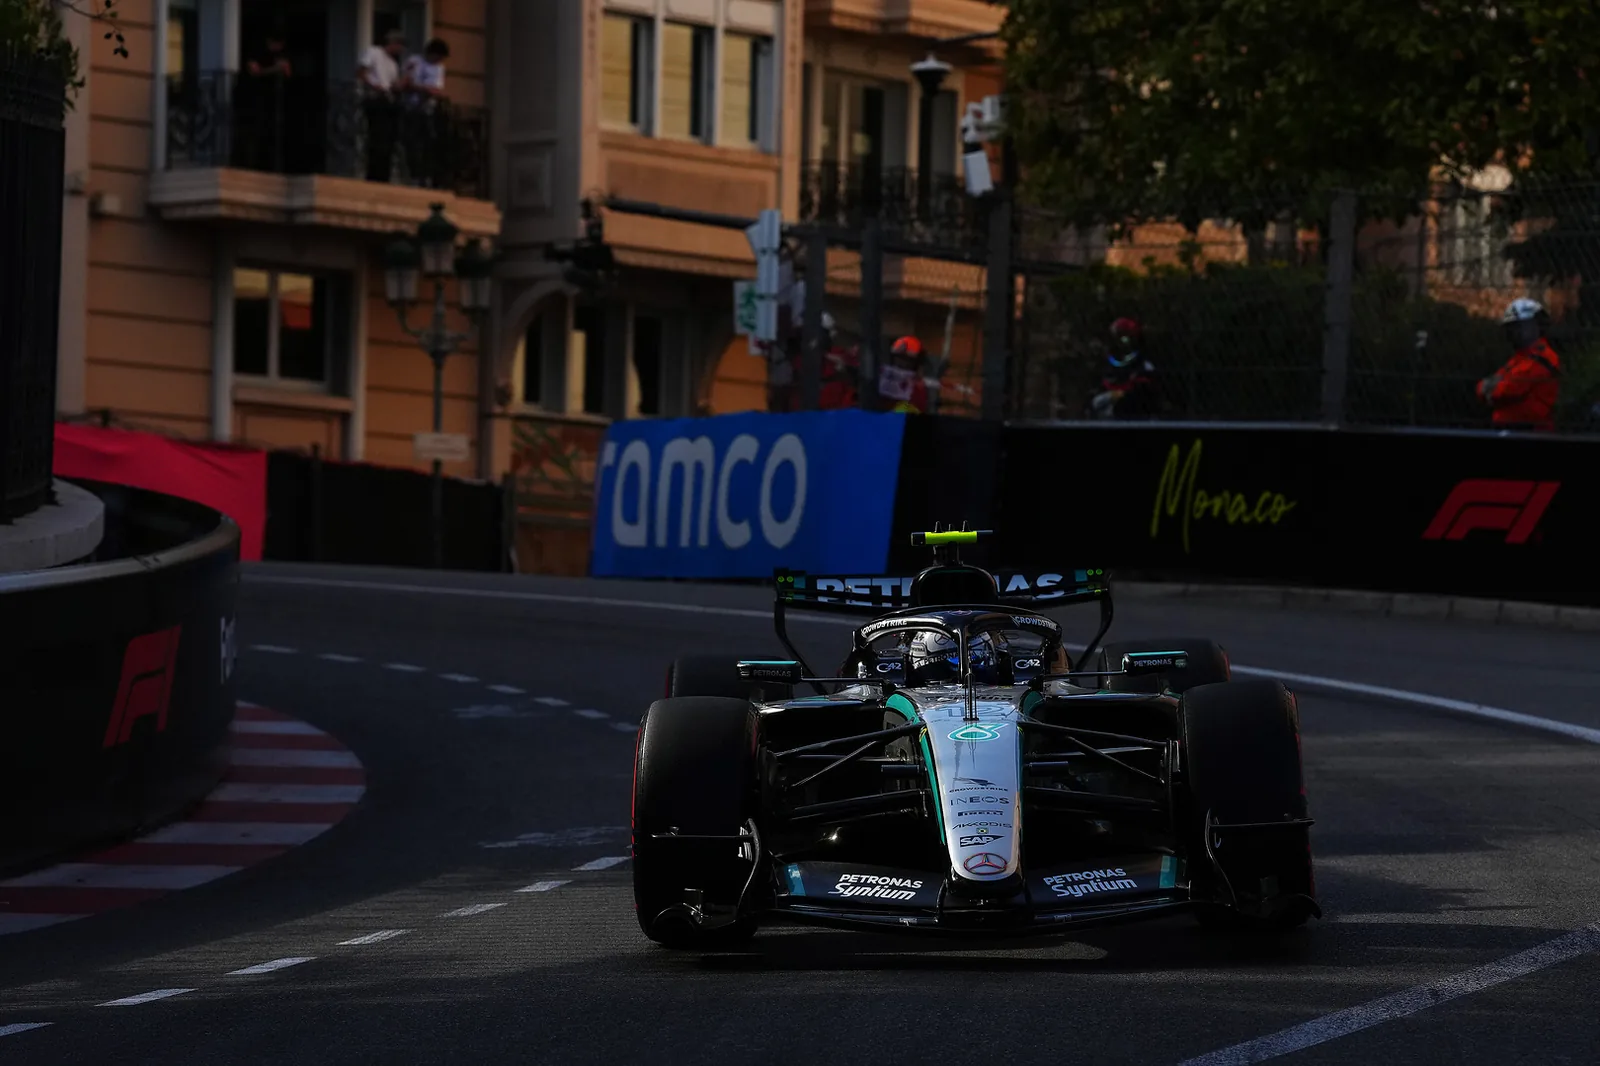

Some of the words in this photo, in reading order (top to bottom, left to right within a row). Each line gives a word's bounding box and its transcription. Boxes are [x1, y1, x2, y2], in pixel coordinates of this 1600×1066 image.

[1149, 438, 1298, 554] Monaco
[816, 573, 1064, 607] PETAS
[861, 619, 908, 635] CROWDSTRIKE
[1133, 658, 1173, 667] PETRONAS
[753, 669, 792, 677] PETRONAS
[950, 796, 1010, 806] INEOS
[960, 834, 997, 847] SAP
[838, 873, 924, 889] PETRONAS
[1043, 867, 1127, 886] PETRONAS
[827, 882, 917, 900] Syntium
[1051, 879, 1138, 898] Syntium
